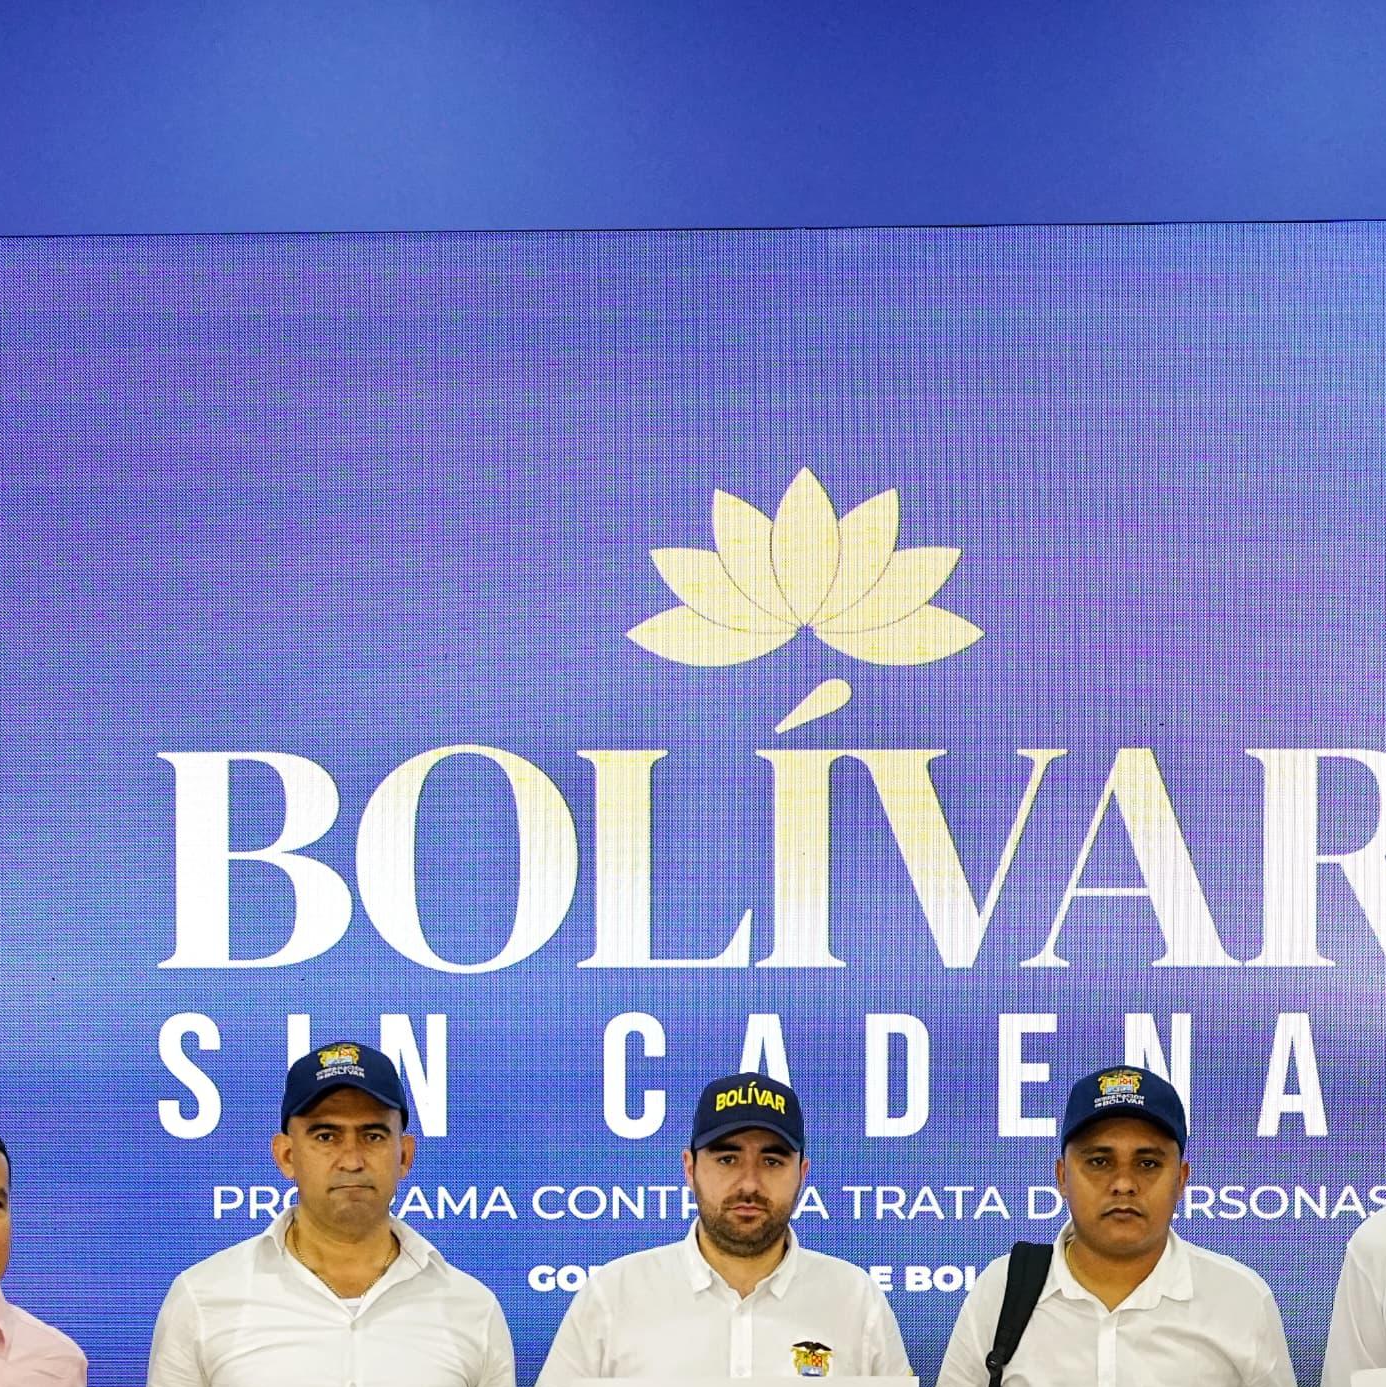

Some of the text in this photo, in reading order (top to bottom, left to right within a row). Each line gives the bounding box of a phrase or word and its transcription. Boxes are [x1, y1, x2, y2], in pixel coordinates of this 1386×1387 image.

[715, 1081, 785, 1115] BOLÍVAR
[213, 1185, 519, 1221] PRAMA
[842, 1185, 1011, 1220] TRATA
